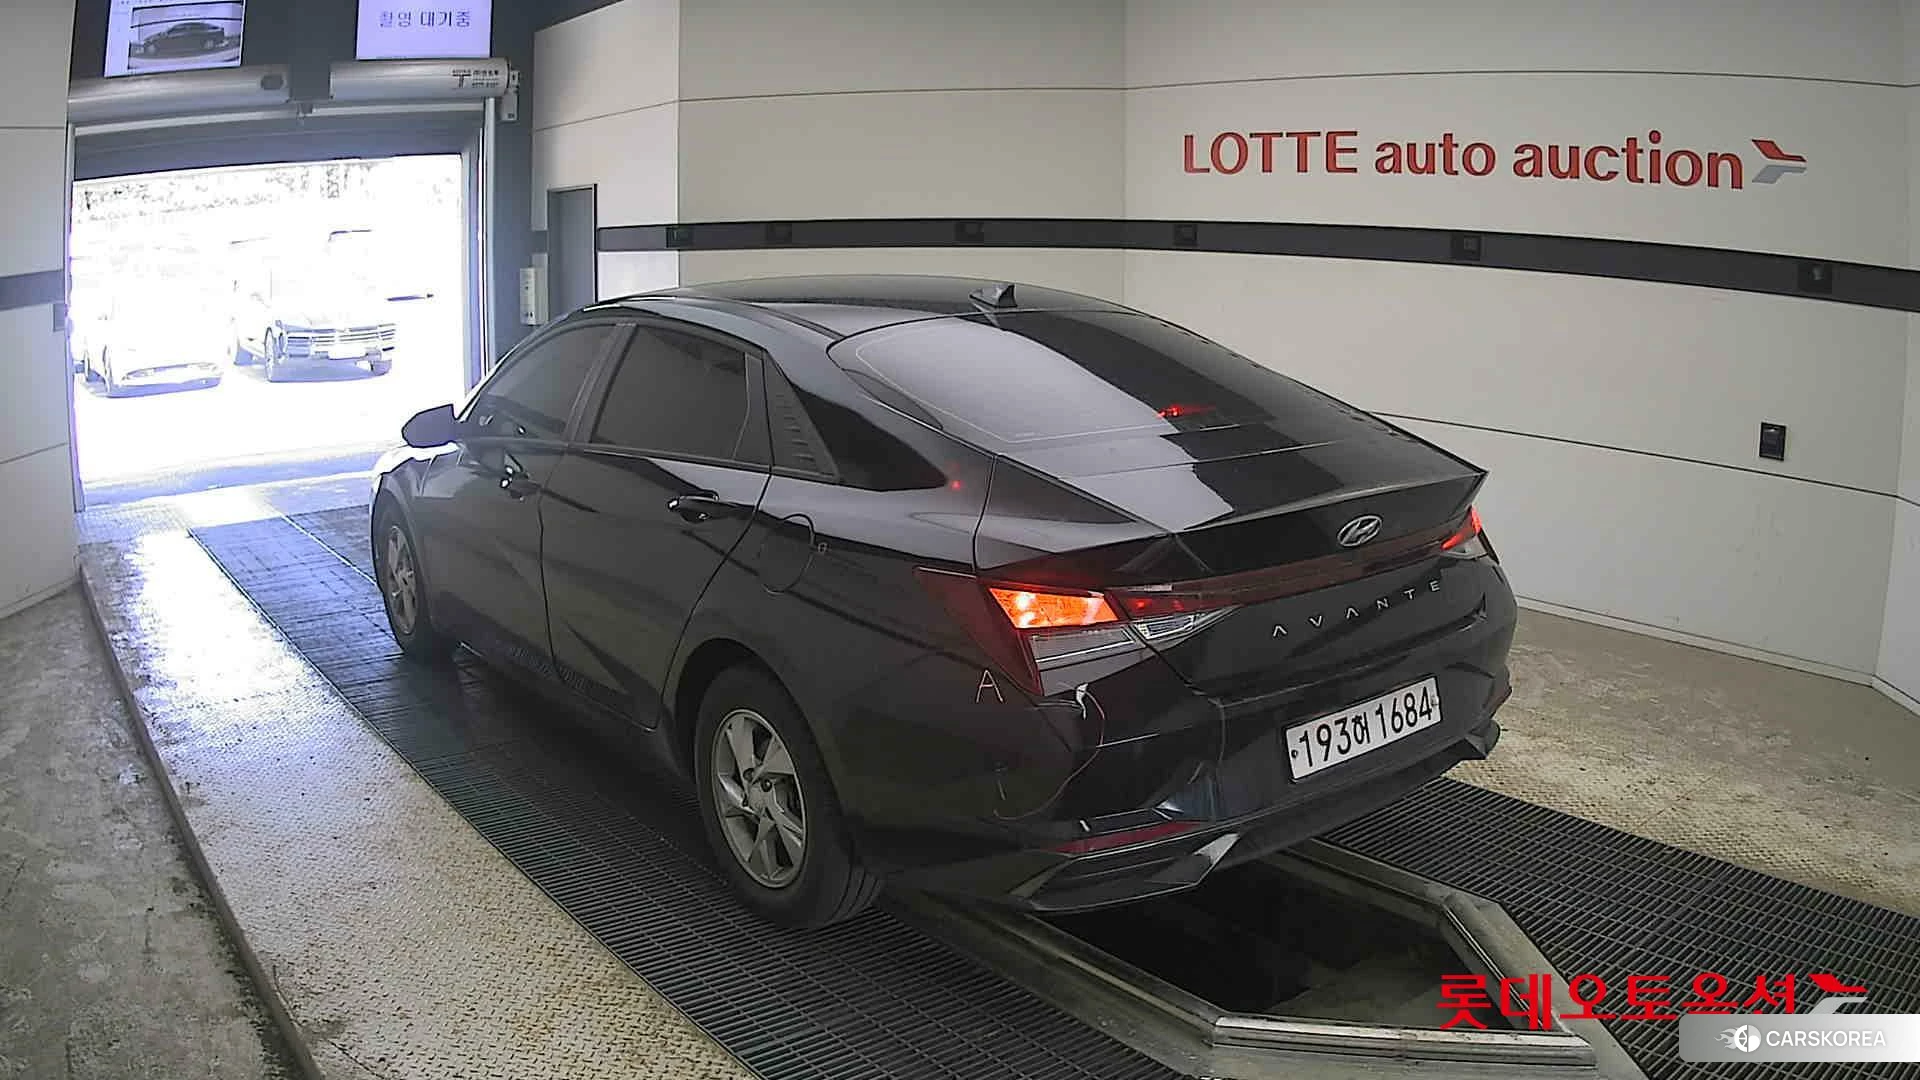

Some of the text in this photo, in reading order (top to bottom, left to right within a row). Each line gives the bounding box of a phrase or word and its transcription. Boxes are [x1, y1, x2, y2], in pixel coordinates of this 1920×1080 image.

[419, 9, 471, 28] 대기중
[1183, 130, 1744, 189] LOTTE auto auction
[1272, 580, 1441, 637] AVANTE
[976, 669, 1004, 704] A
[1299, 686, 1433, 767] 193허 1684
